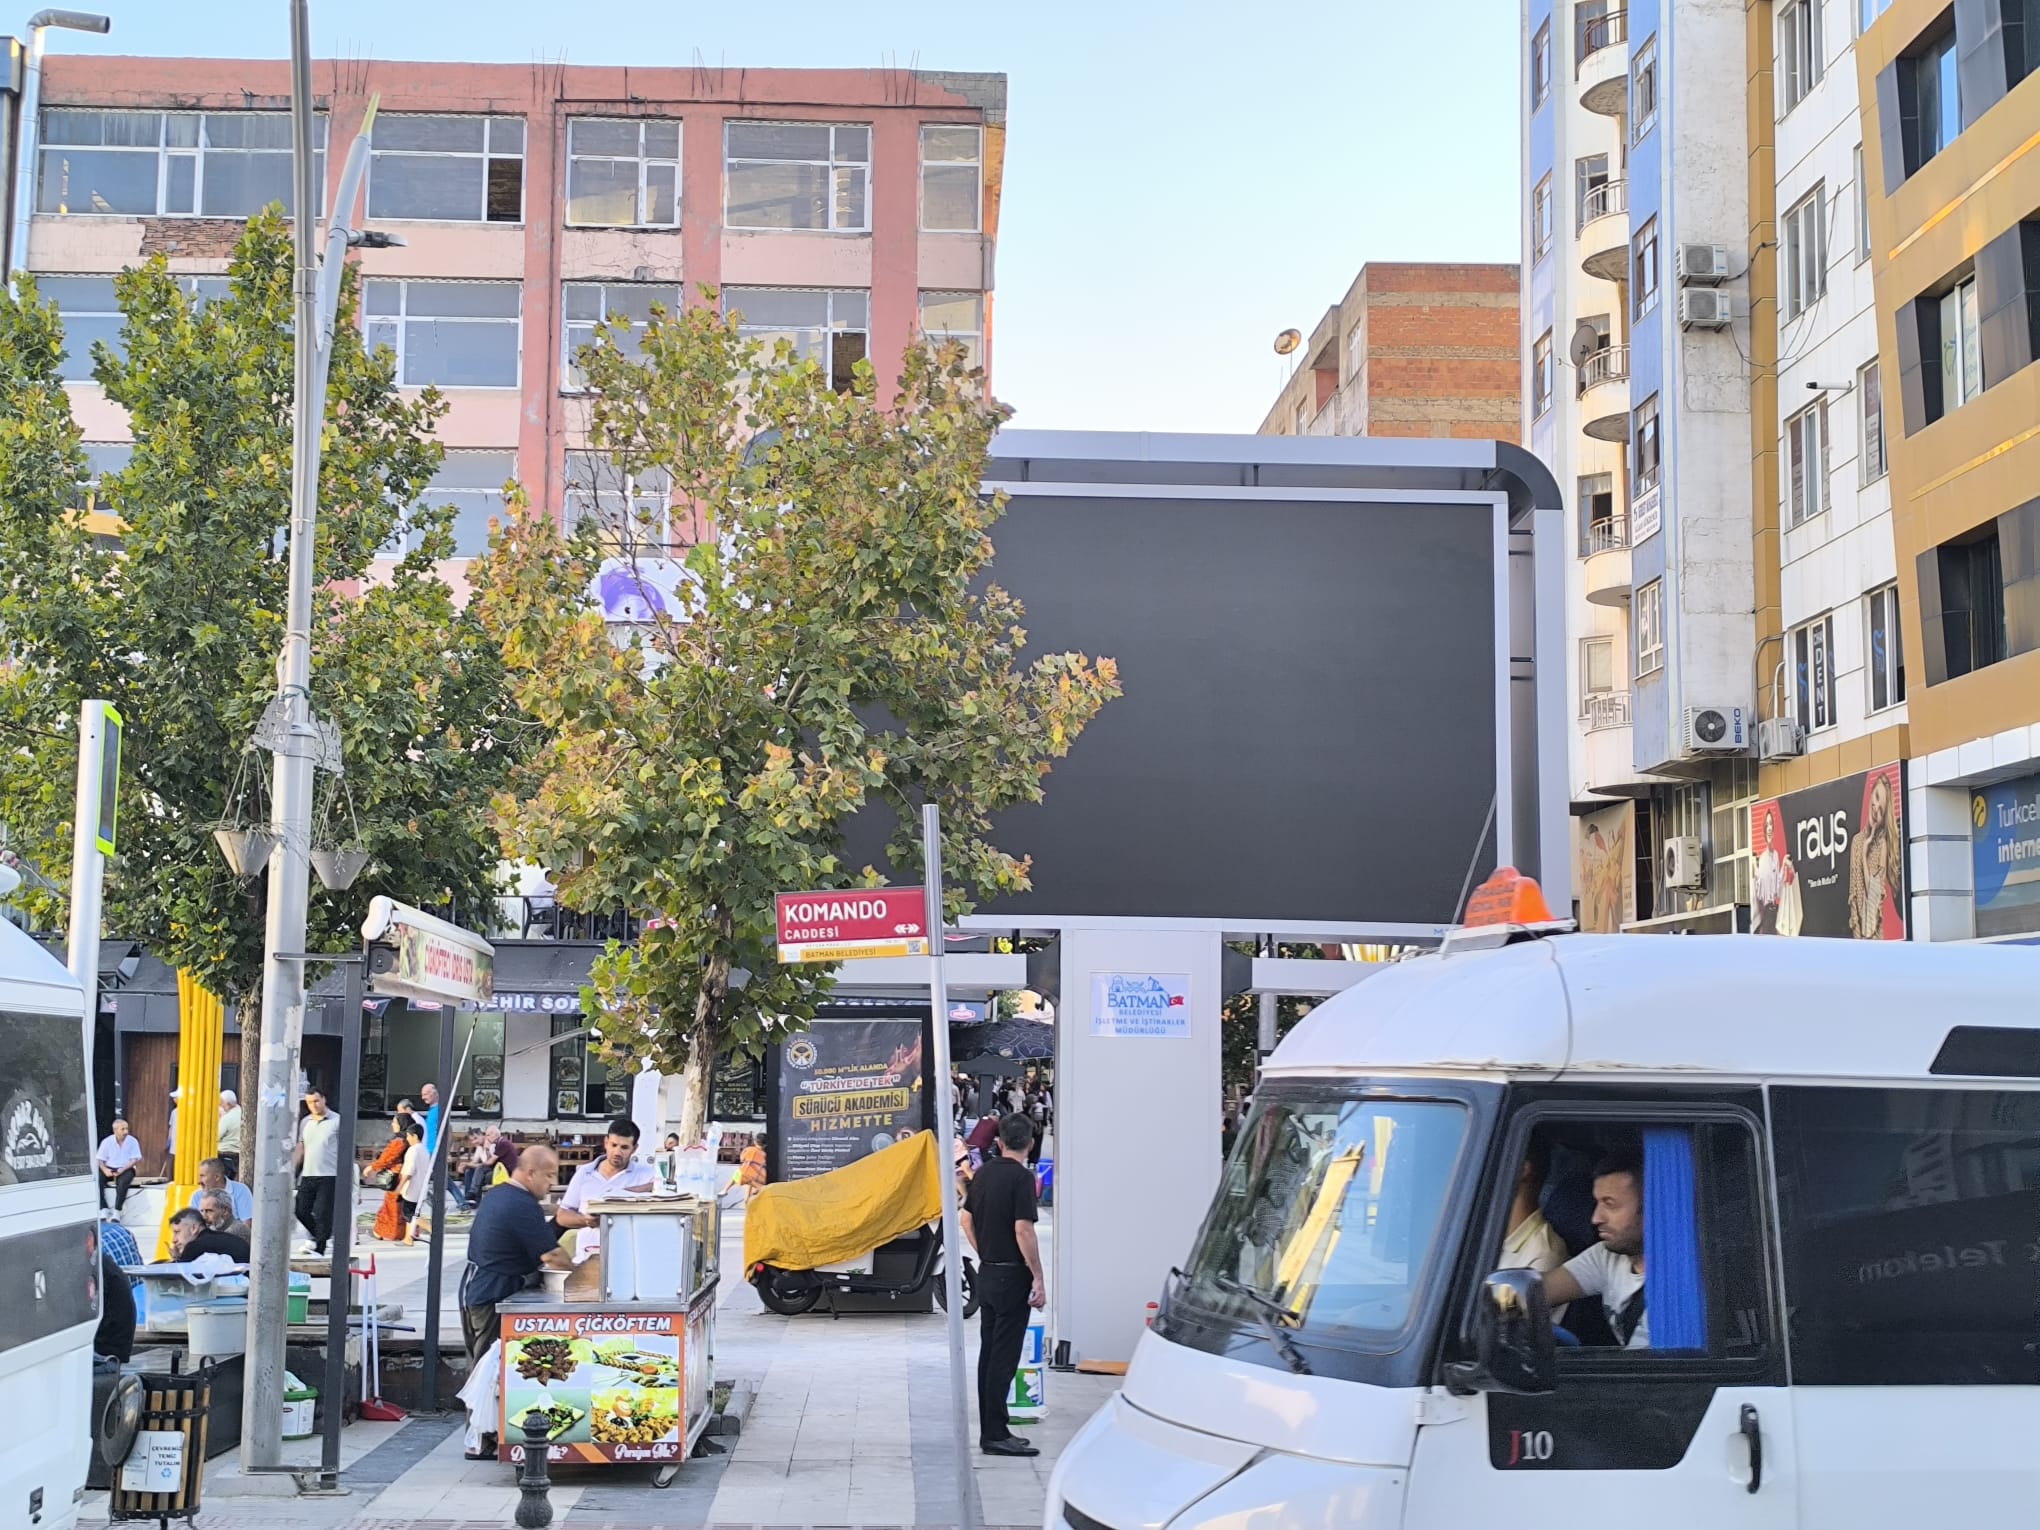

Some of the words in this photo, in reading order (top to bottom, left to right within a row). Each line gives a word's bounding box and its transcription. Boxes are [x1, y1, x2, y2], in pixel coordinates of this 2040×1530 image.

[1815, 647, 1825, 722] DENT
[1734, 708, 1742, 743] BEKO
[1797, 809, 1848, 869] rays
[785, 900, 887, 923] KOMANDO
[785, 926, 839, 940] CADDESİ
[805, 950, 834, 959] BATMAN
[836, 947, 876, 957] BELEDİYESİ
[1108, 993, 1170, 1008] BATMAN
[1095, 1017, 1128, 1025] İŞLETME
[1119, 1008, 1162, 1016] BELEDİYESİ
[1115, 1026, 1166, 1034] MÜDÜRLÜĞÜ
[799, 1097, 841, 1115] SÜRÜCÜ
[844, 1091, 904, 1111] AKADEMİSİ
[811, 1114, 893, 1131] HİZMETTE
[514, 1318, 570, 1332] USTAM
[574, 1314, 672, 1335] ÇİĞKÖFTEM
[1508, 1430, 1554, 1465] J10
